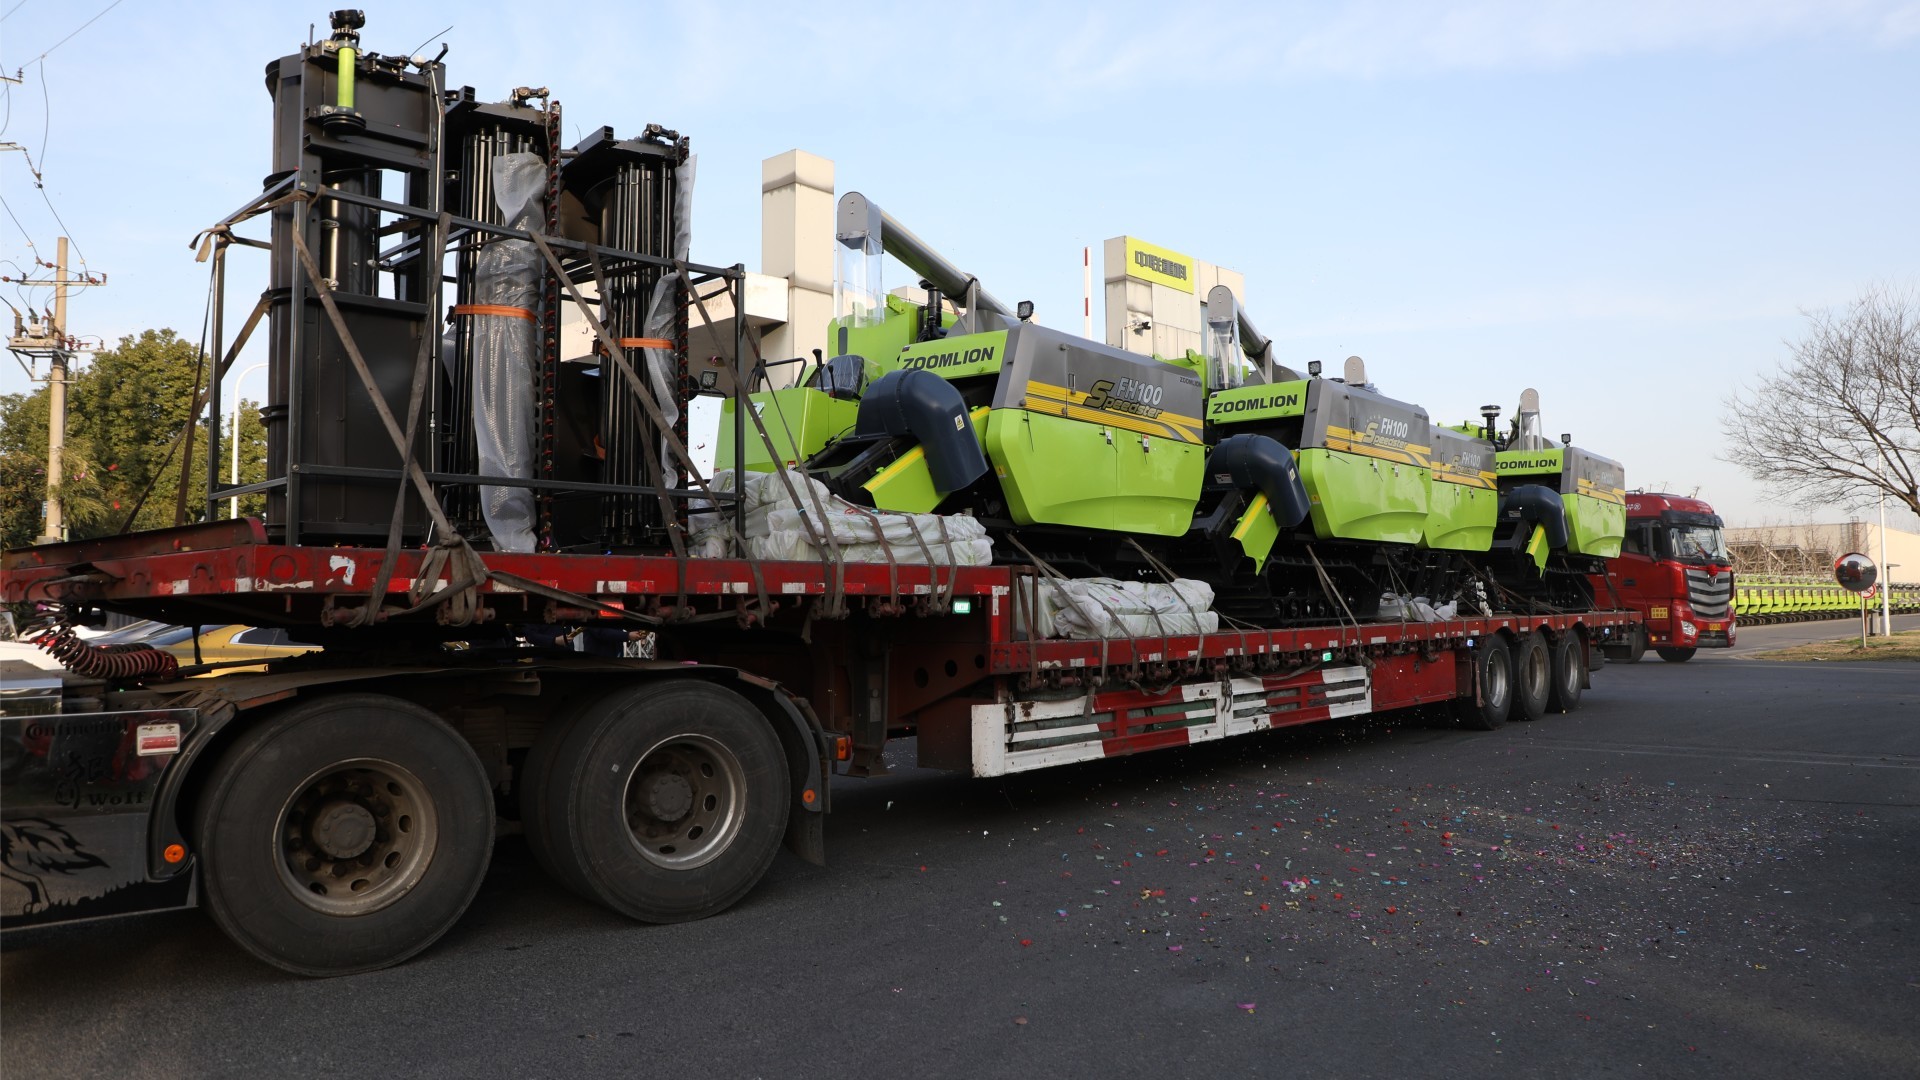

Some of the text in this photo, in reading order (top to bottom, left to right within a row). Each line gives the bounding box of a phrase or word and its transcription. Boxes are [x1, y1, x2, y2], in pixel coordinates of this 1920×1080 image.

[902, 346, 995, 371] ZOOMLION
[1083, 380, 1164, 419] Speedster
[1116, 376, 1163, 406] FH100
[1212, 394, 1298, 414] ZOOMLION
[1362, 421, 1408, 450] Speedster
[1381, 418, 1408, 439] FH100
[1495, 459, 1557, 470] ZOOMLION
